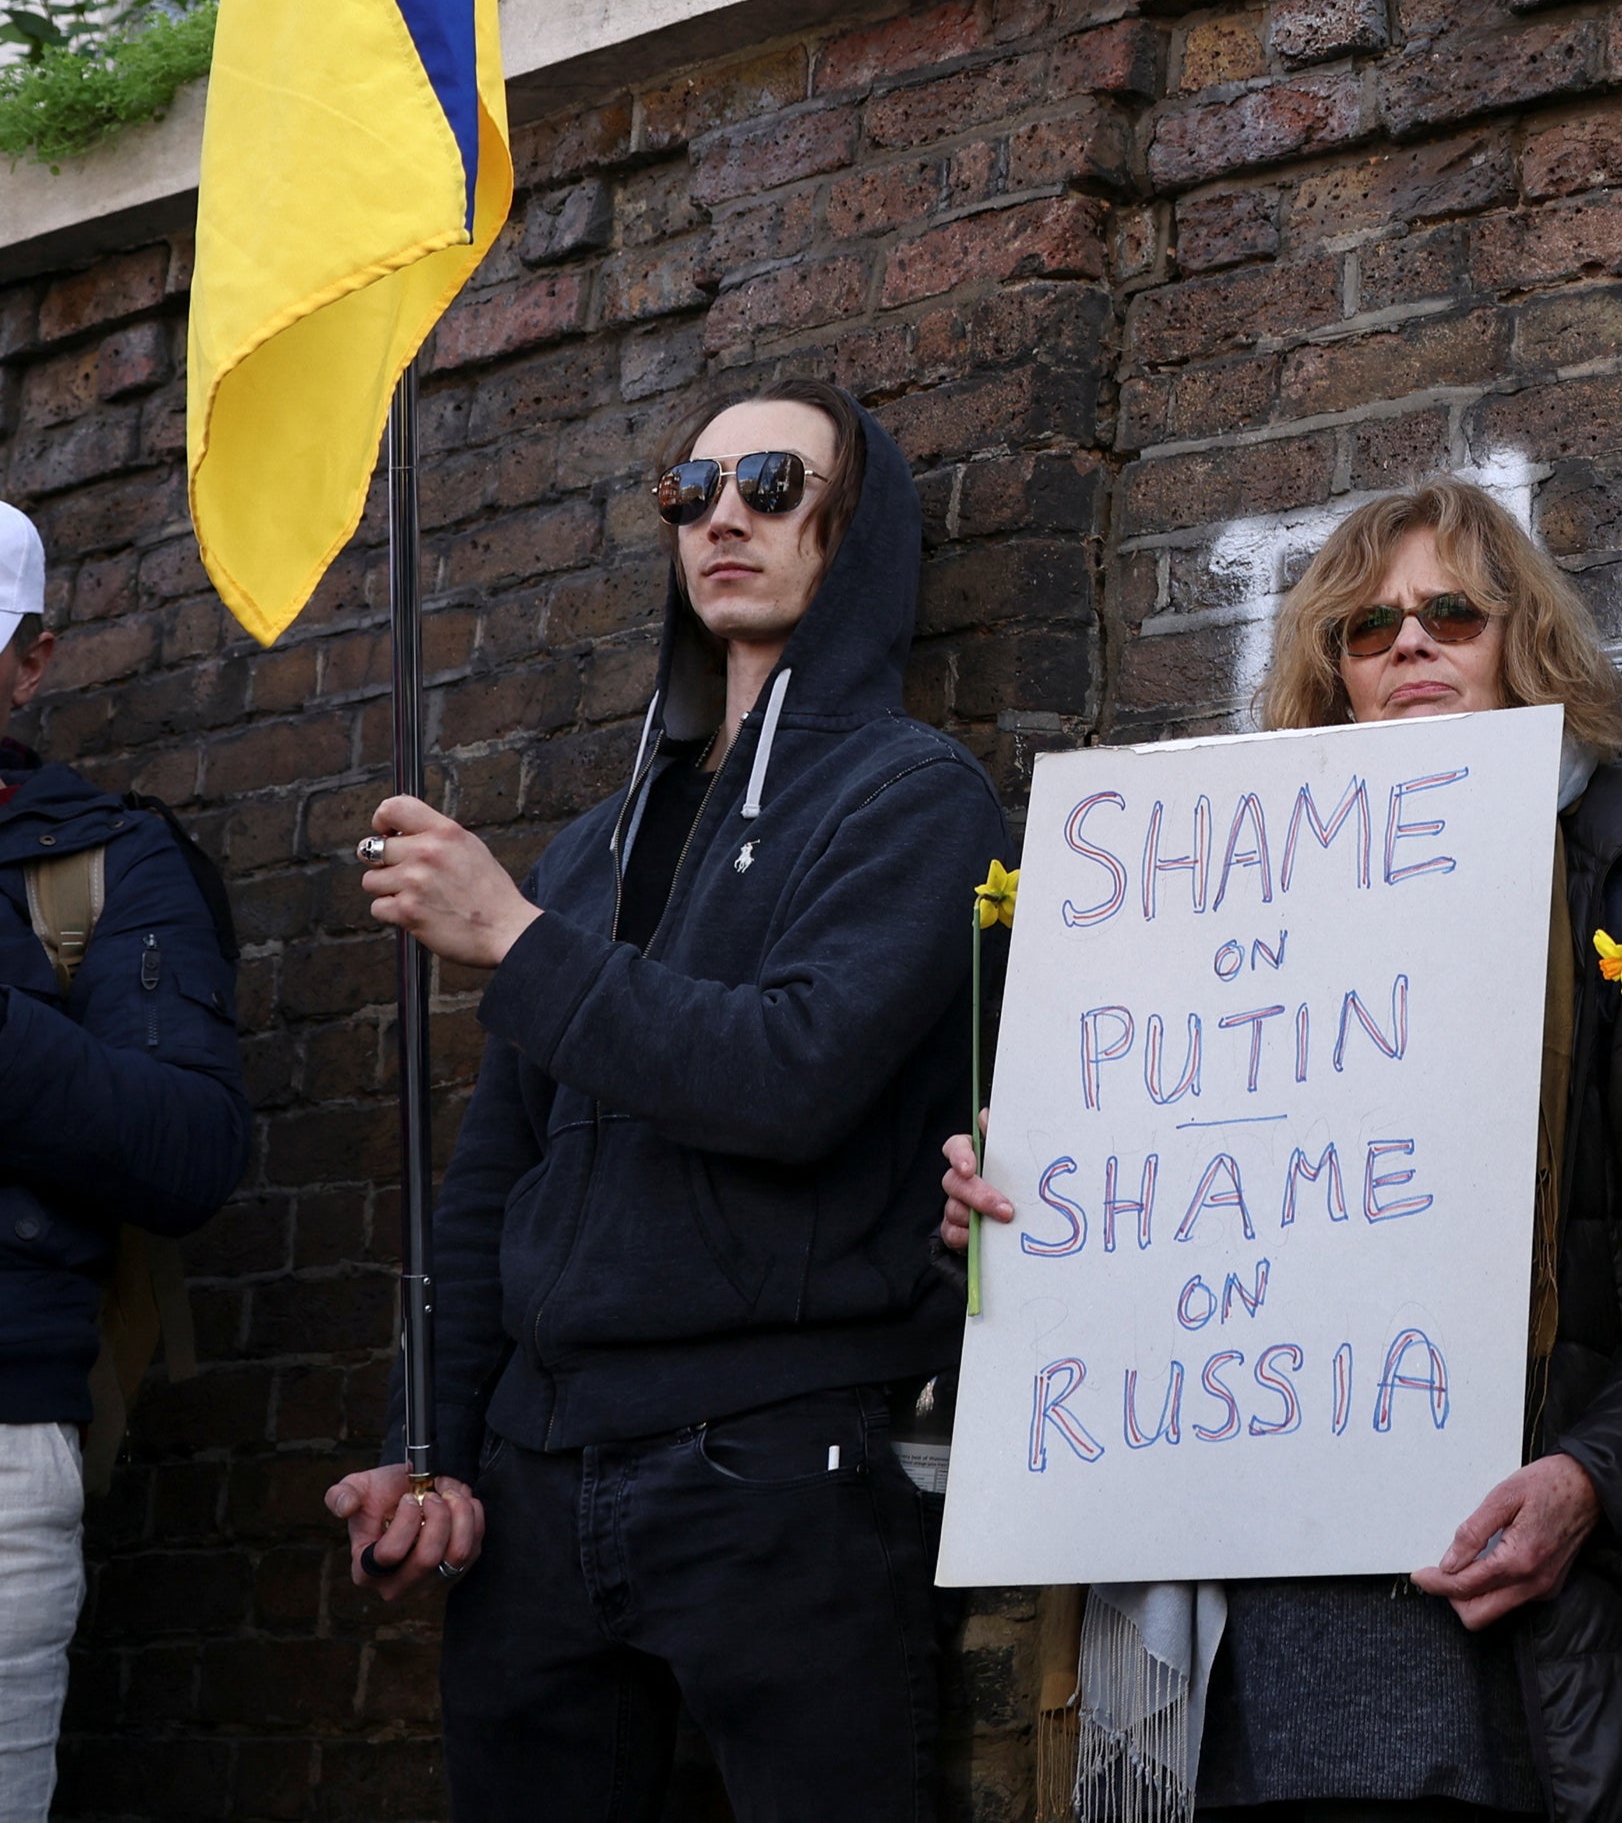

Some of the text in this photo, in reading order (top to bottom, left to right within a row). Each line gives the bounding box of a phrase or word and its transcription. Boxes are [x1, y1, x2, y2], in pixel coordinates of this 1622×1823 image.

[1061, 766, 1470, 930] SHAME
[1213, 929, 1288, 982] ON
[1080, 974, 1409, 1110] PUTIN
[1020, 1137, 1434, 1258] SHAME
[1177, 1258, 1270, 1330] ON
[1028, 1327, 1451, 1473] RUSSIA
